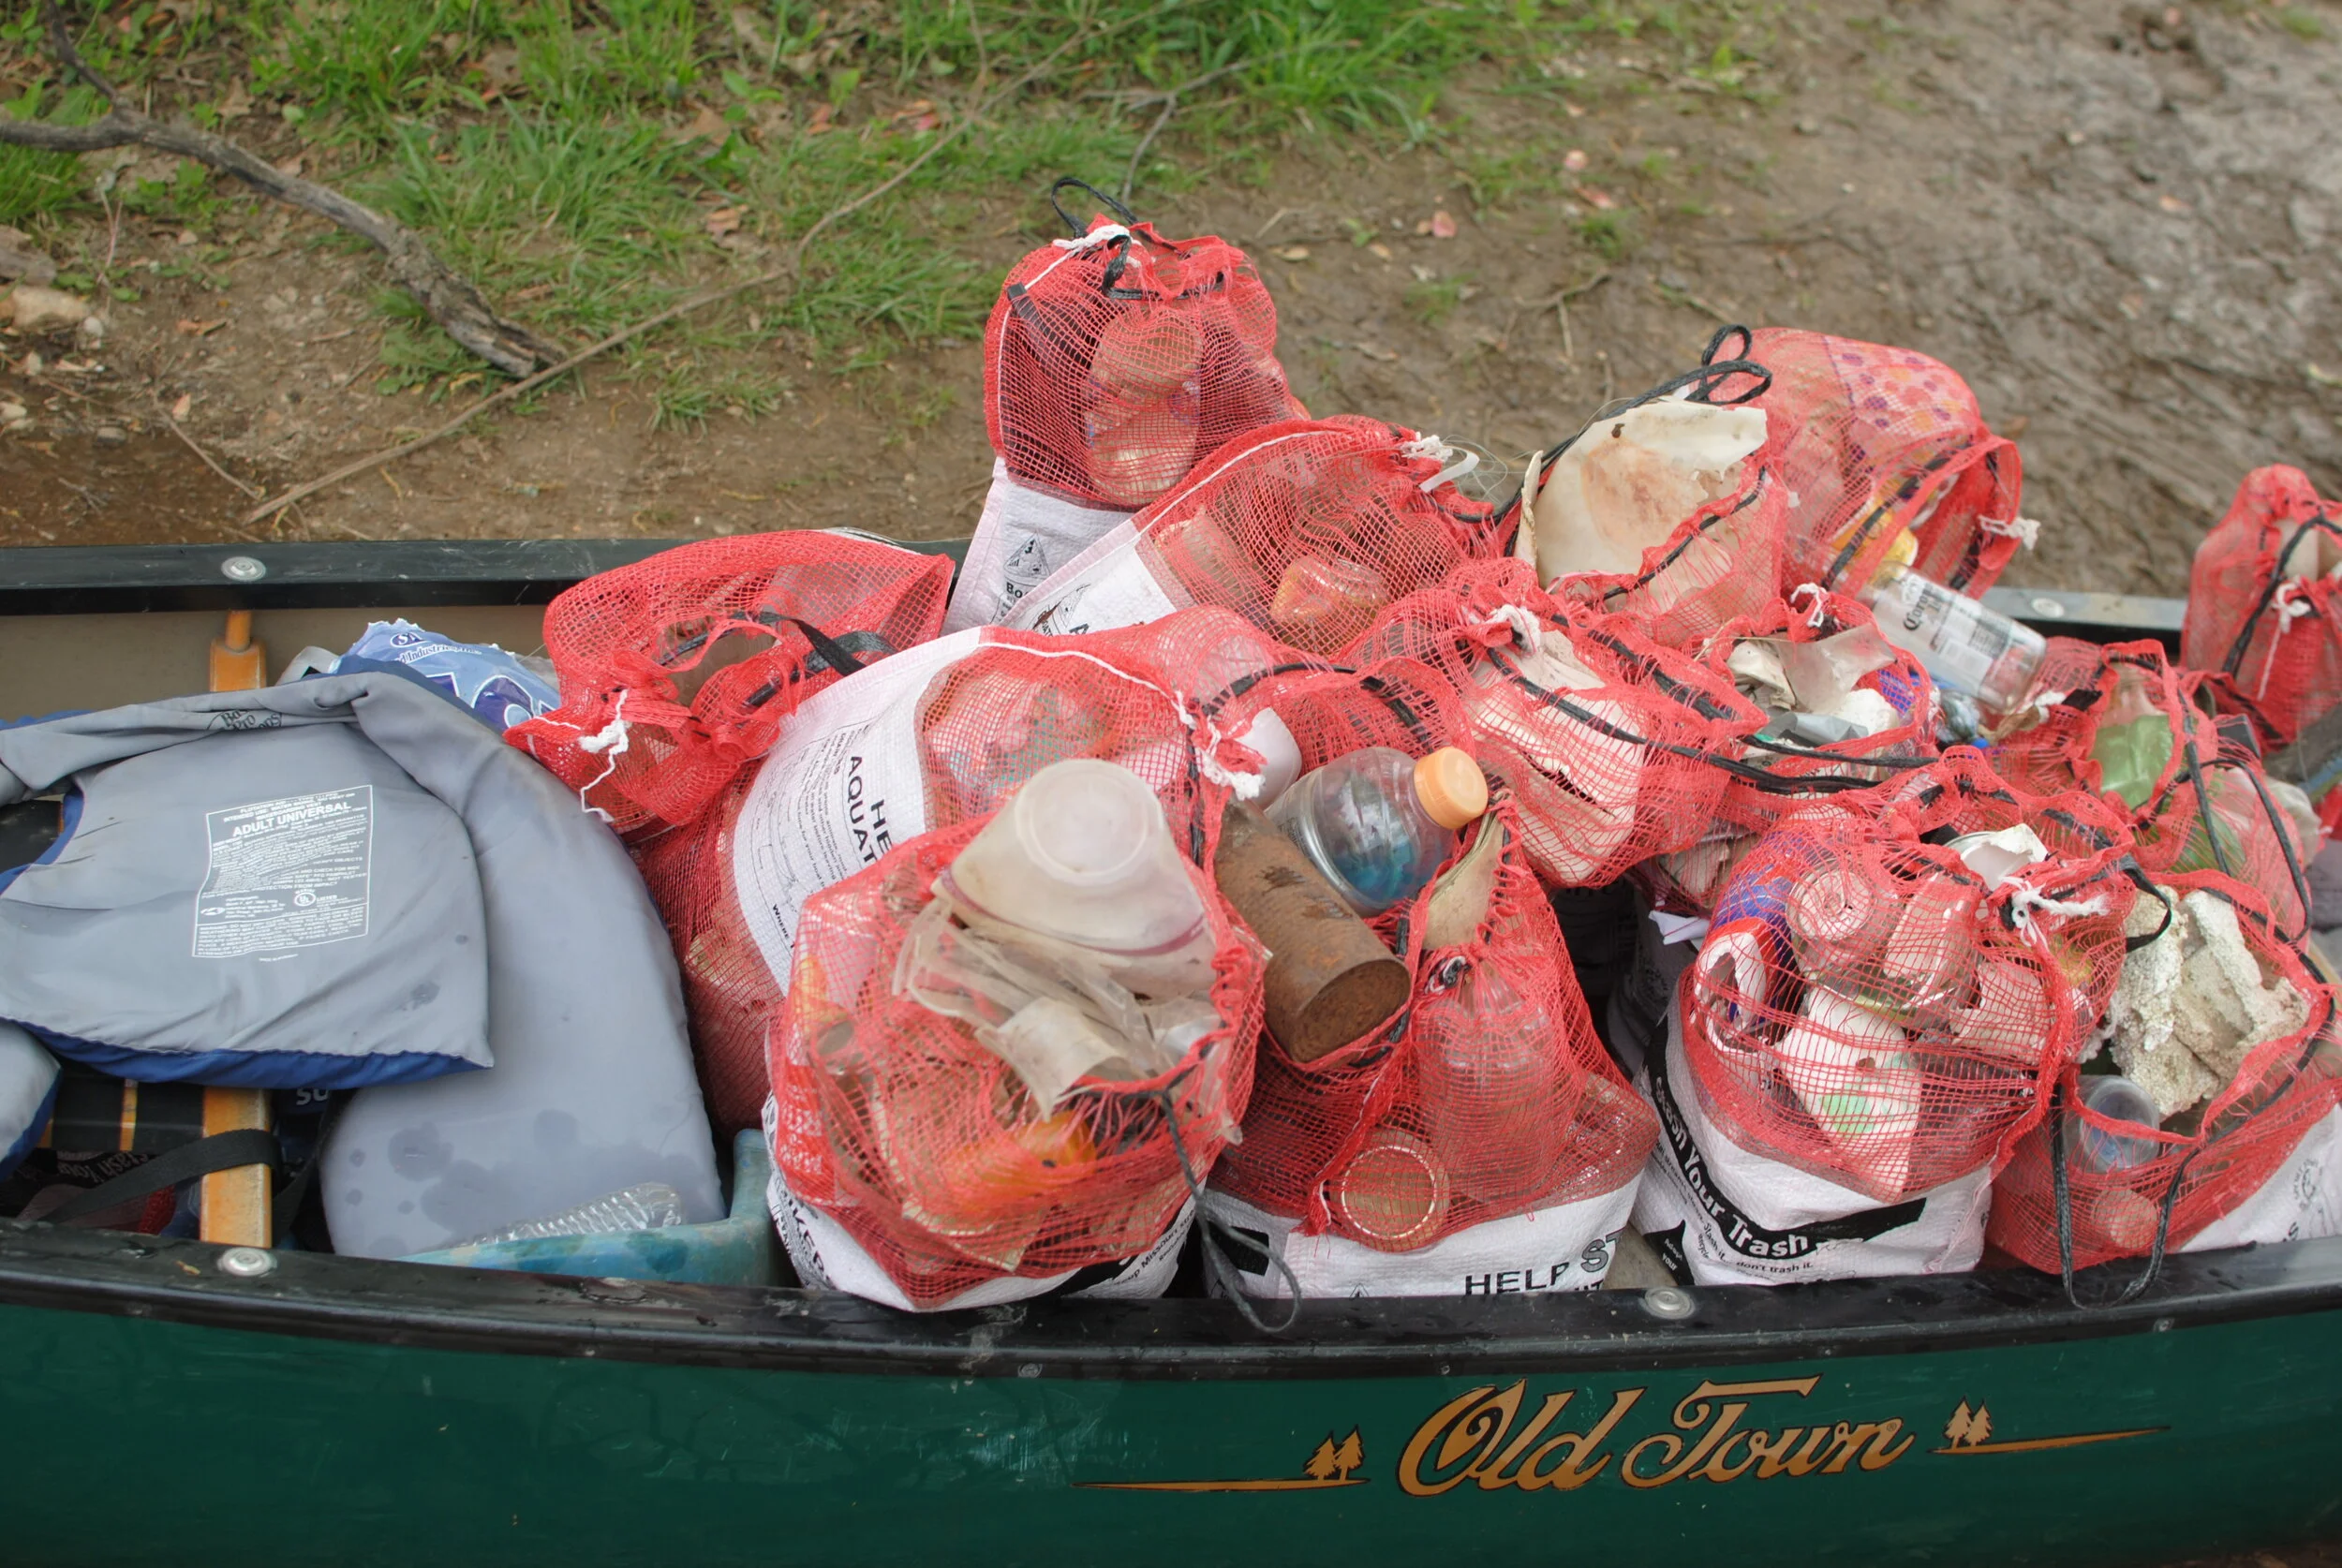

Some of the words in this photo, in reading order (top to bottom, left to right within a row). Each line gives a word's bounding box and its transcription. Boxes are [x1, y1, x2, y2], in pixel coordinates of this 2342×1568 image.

[232, 817, 274, 837] ADULT
[276, 802, 353, 825] UNIVERSAL
[847, 756, 878, 864] AQUAT
[870, 799, 893, 856] HE
[1683, 1145, 1726, 1219] Your
[1727, 1213, 1809, 1258] Trash
[1141, 1229, 1178, 1268] Missouri
[1703, 1222, 1718, 1251] Stash
[1736, 1261, 1766, 1272] don't
[1769, 1264, 1800, 1274] trash
[1464, 1262, 1570, 1296] HELP
[1397, 1377, 1649, 1498] Old
[1620, 1373, 1917, 1489] Town
